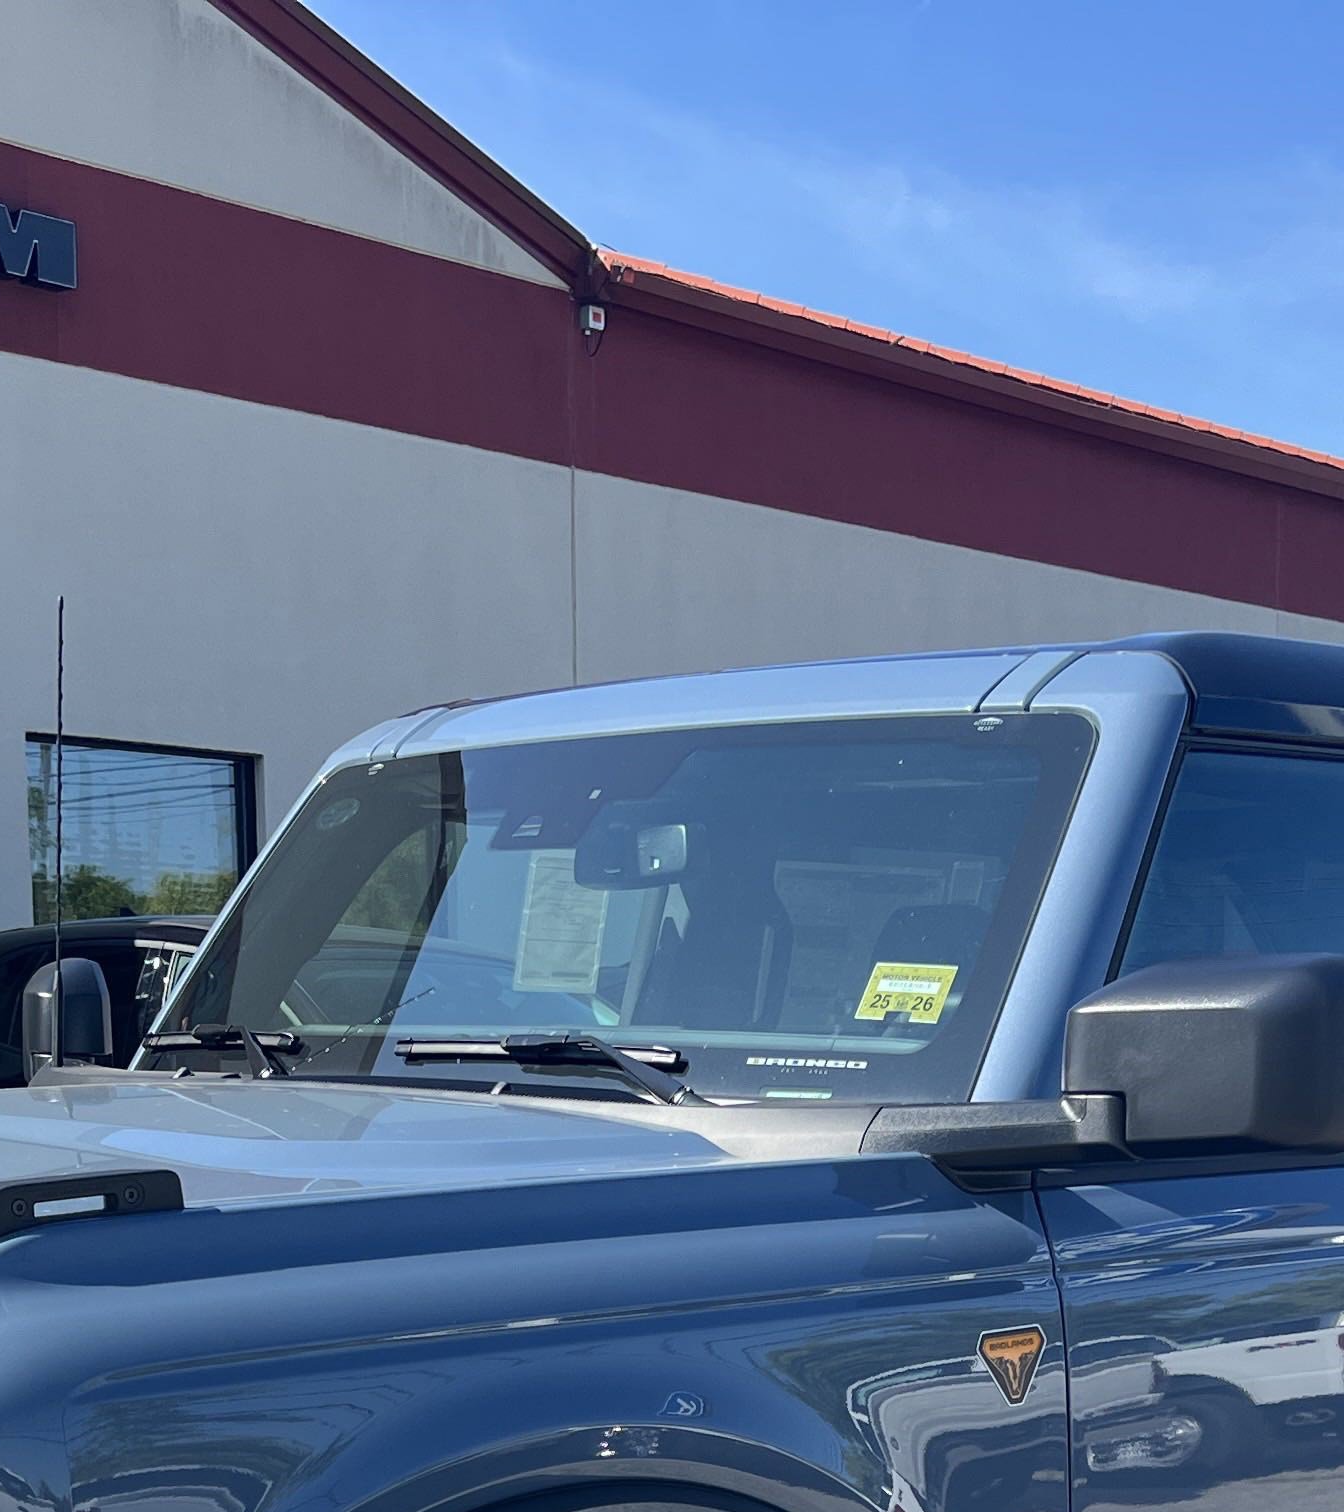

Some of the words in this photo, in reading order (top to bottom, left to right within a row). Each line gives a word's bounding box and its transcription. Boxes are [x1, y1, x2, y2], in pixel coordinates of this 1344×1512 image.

[869, 994, 893, 1009] 25
[911, 996, 935, 1012] 26
[746, 1056, 868, 1070] BRONCO
[989, 1337, 1034, 1351] BADLANDS
